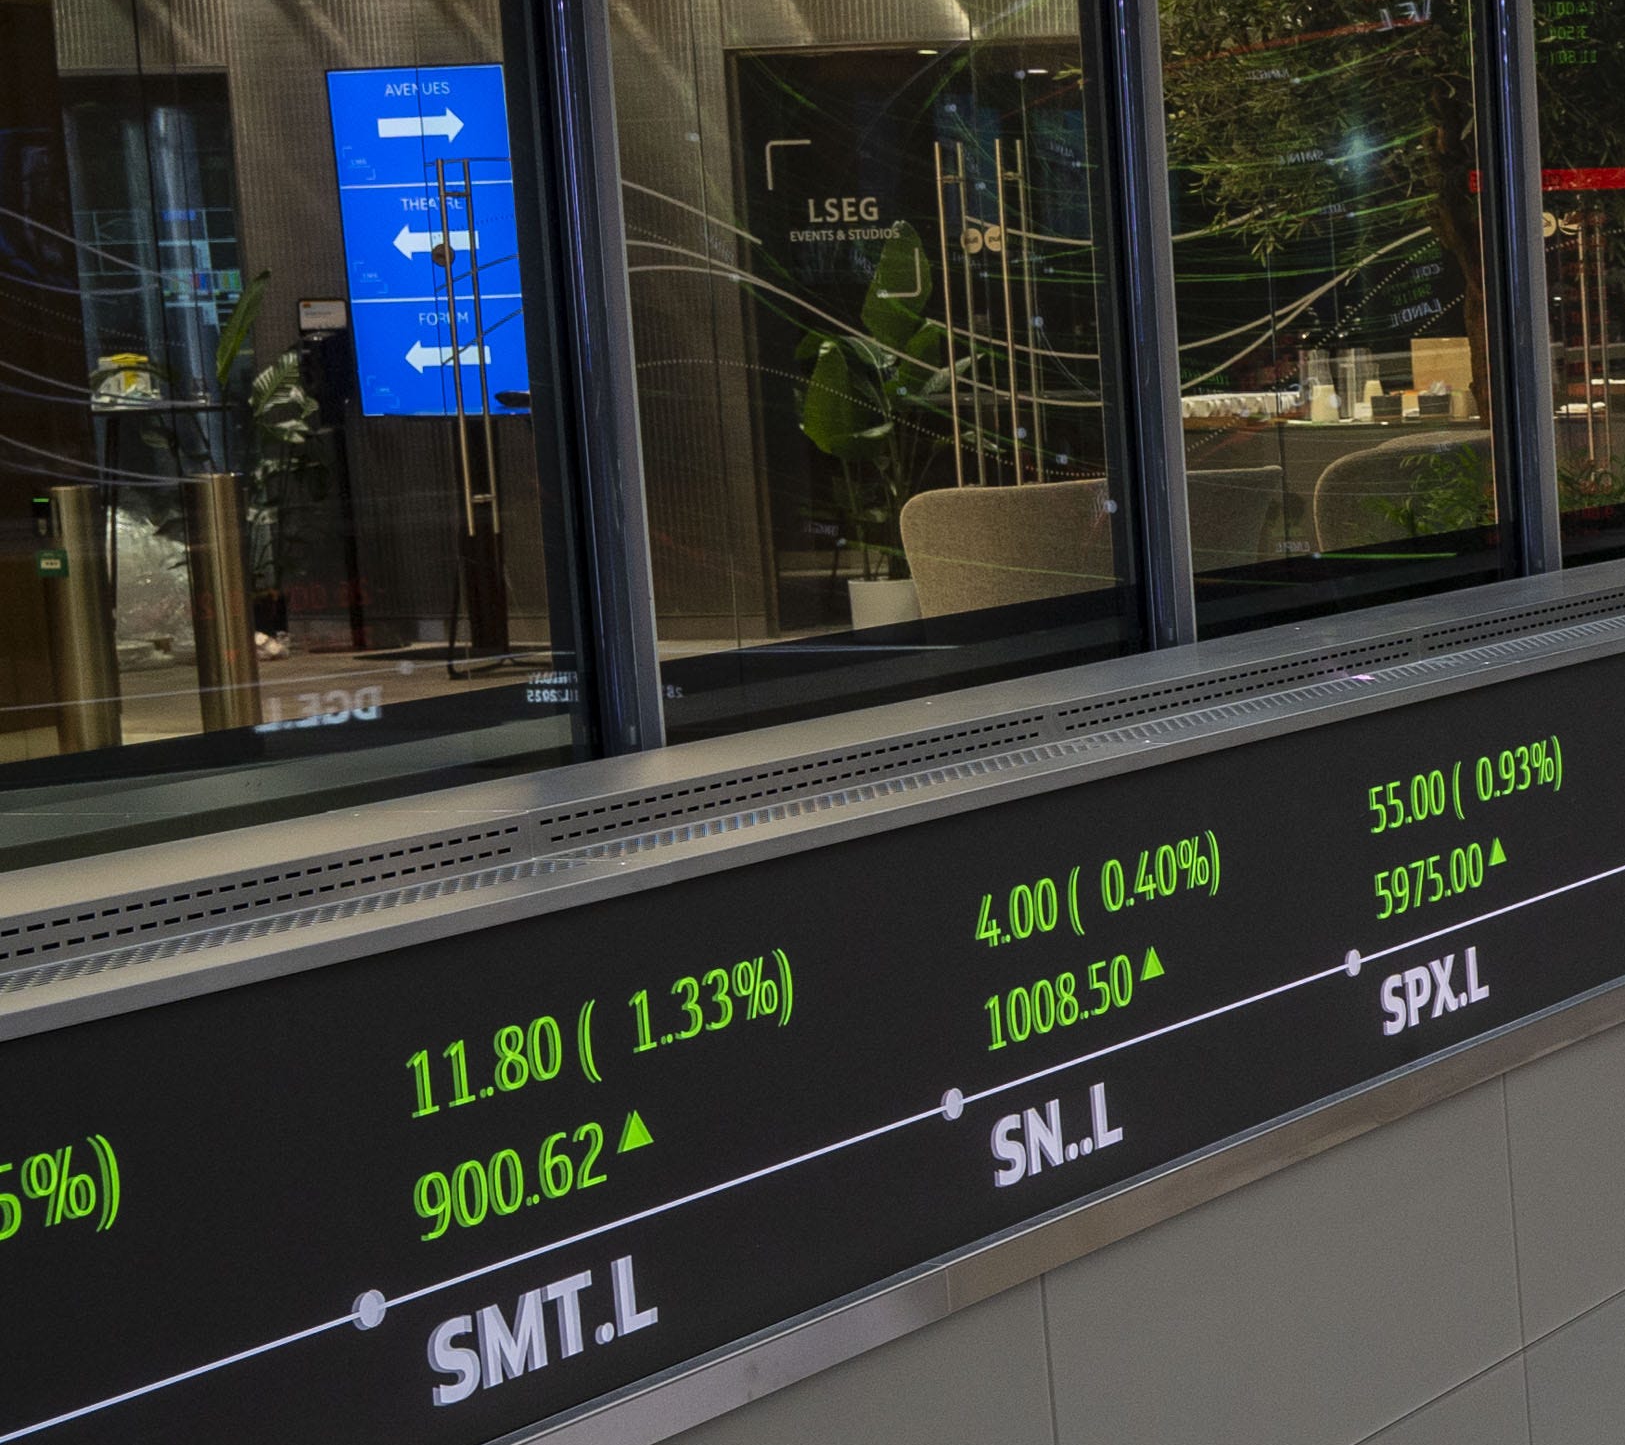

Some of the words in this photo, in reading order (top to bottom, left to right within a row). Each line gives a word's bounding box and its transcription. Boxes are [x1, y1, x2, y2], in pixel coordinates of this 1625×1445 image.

[790, 230, 833, 242] EVENTS
[836, 230, 845, 241] &
[848, 228, 900, 240] STUDIOS
[808, 197, 879, 223] LSEG
[1375, 843, 1483, 919] 5975.00
[985, 955, 1132, 1050] 1008.50
[1381, 946, 1489, 1035] SPX.L
[991, 1082, 1123, 1187] SN..L
[414, 1123, 607, 1241] 900.62
[427, 1255, 658, 1406] SMT.L
